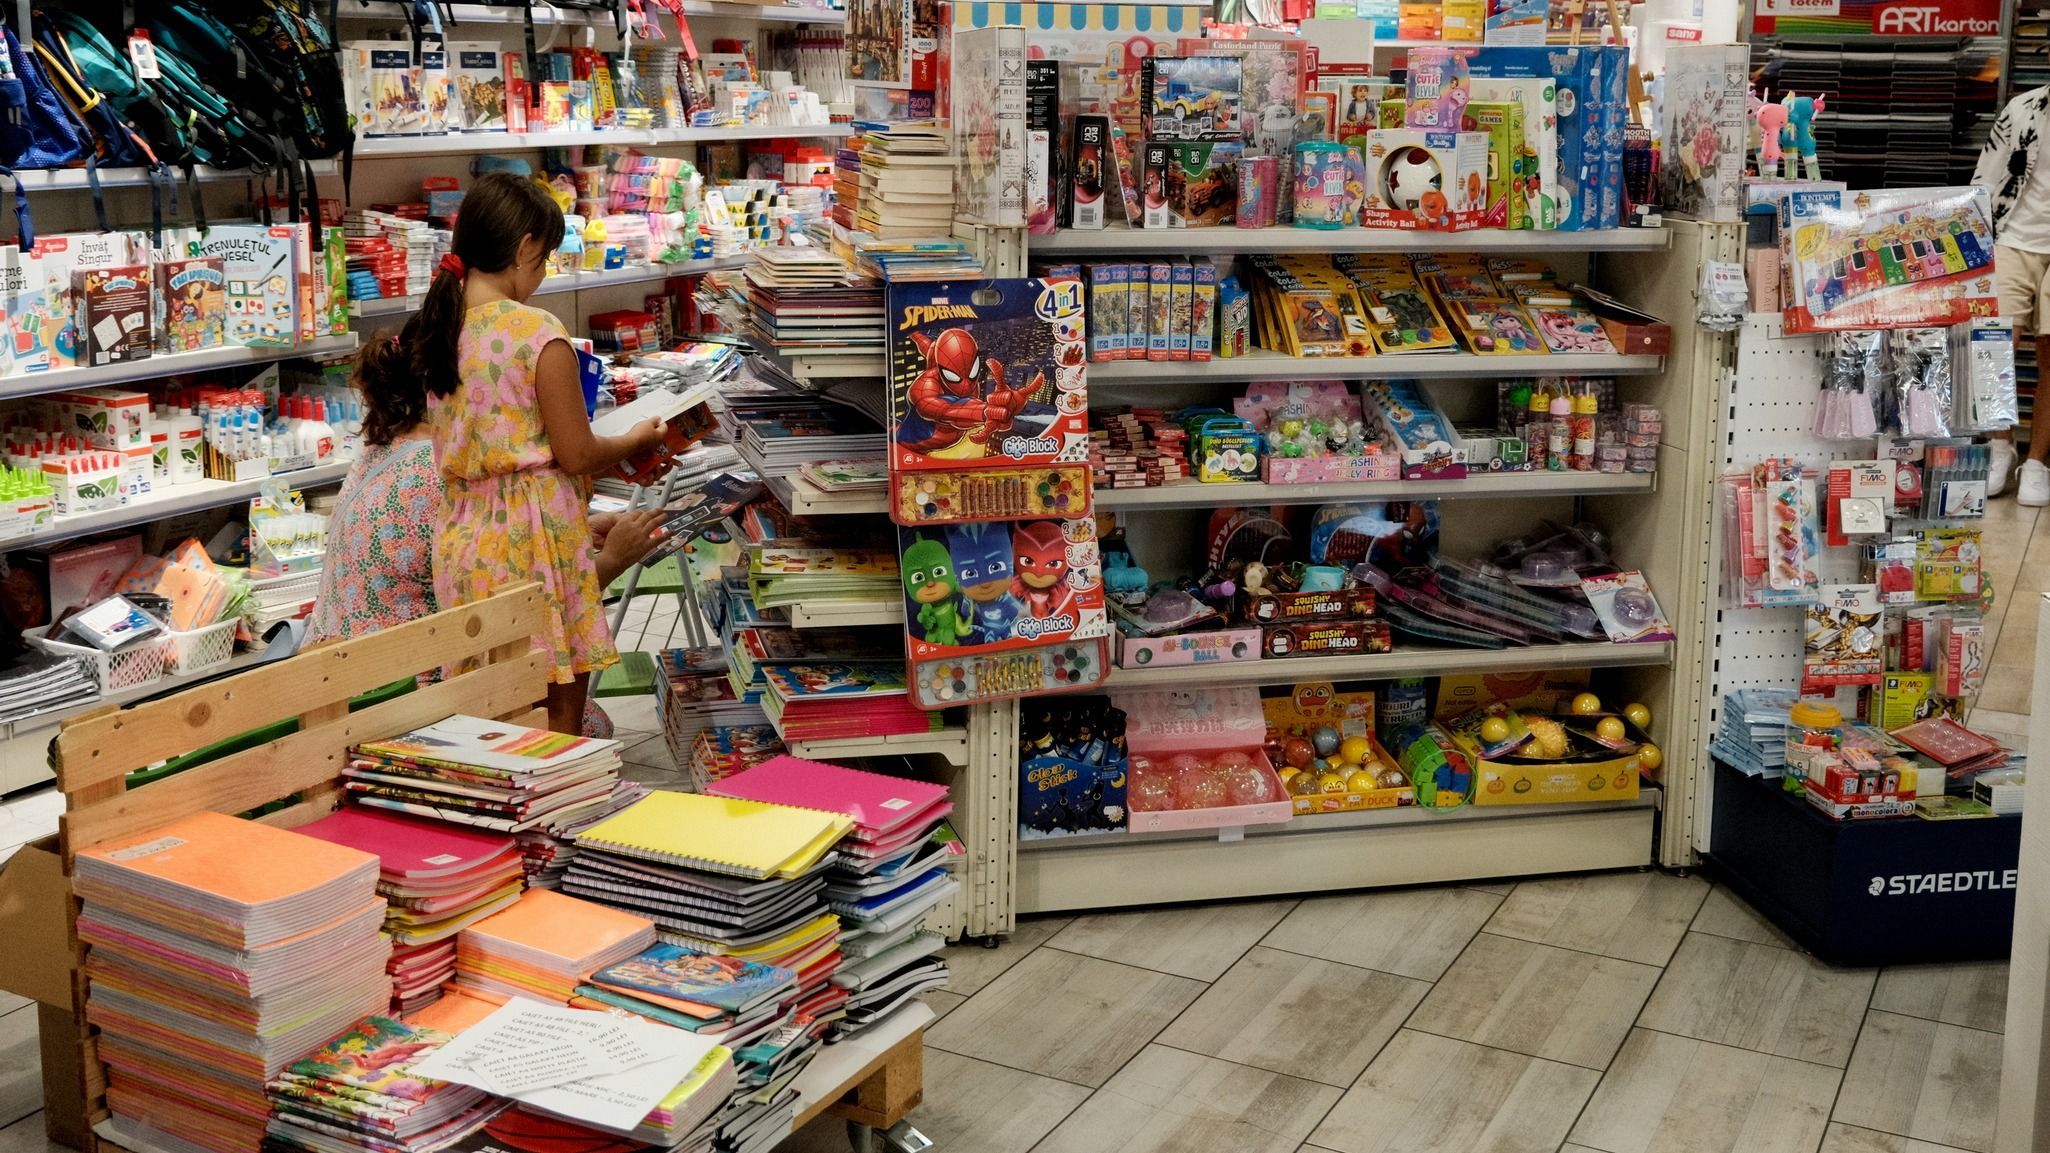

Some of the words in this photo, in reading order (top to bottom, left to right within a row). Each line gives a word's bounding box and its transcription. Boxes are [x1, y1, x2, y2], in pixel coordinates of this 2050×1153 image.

[1669, 29, 1696, 39] sano
[1213, 41, 1256, 49] Castorland
[1259, 40, 1281, 49] Puzzle
[1416, 74, 1440, 84] CUTIE
[910, 98, 930, 108] 200
[1800, 193, 1836, 202] BONTEMPI
[1366, 210, 1389, 219] Shape
[1545, 208, 1554, 223] DAS
[1366, 219, 1398, 229] Activity
[1400, 219, 1416, 227] Ball
[78, 253, 113, 267] Singur
[1112, 271, 1127, 279] 120
[1152, 270, 1169, 280] 60
[1043, 290, 1057, 316] 4
[1059, 294, 1069, 307] in
[1069, 284, 1081, 310] 1
[900, 305, 978, 330] SPIDER-MAN
[1054, 324, 1060, 333] 1
[1054, 345, 1061, 356] 2
[1056, 369, 1063, 380] 3
[1056, 396, 1063, 407] 4
[1004, 439, 1028, 458] Giga
[1029, 438, 1057, 453] Block
[1889, 448, 1913, 457] FIMO
[1063, 524, 1069, 534] 2
[1066, 549, 1073, 559] 3
[1068, 573, 1075, 584] 4
[1295, 596, 1331, 605] SQUISHY
[1018, 619, 1042, 637] Giga
[1043, 616, 1072, 631] Block
[1309, 630, 1345, 639] SQUISHY
[1900, 680, 1922, 688] FIMO
[1028, 763, 1065, 782] Glow
[1039, 769, 1077, 791] Stick
[1349, 798, 1365, 806] FAT
[1368, 797, 1395, 806] DUCK
[1888, 869, 2017, 895] STAEDTLE
[521, 1011, 542, 1019] CAIET
[512, 1018, 533, 1026] CAIET
[555, 1025, 569, 1033] FILE
[503, 1025, 524, 1033] CAIET
[547, 1032, 561, 1041] FILE
[483, 1058, 505, 1067] CAIET
[551, 1044, 573, 1053] NEON
[609, 1026, 621, 1034] LEI
[623, 1040, 634, 1048] LEI
[557, 1051, 579, 1059] NEON
[630, 1046, 641, 1054] LEI
